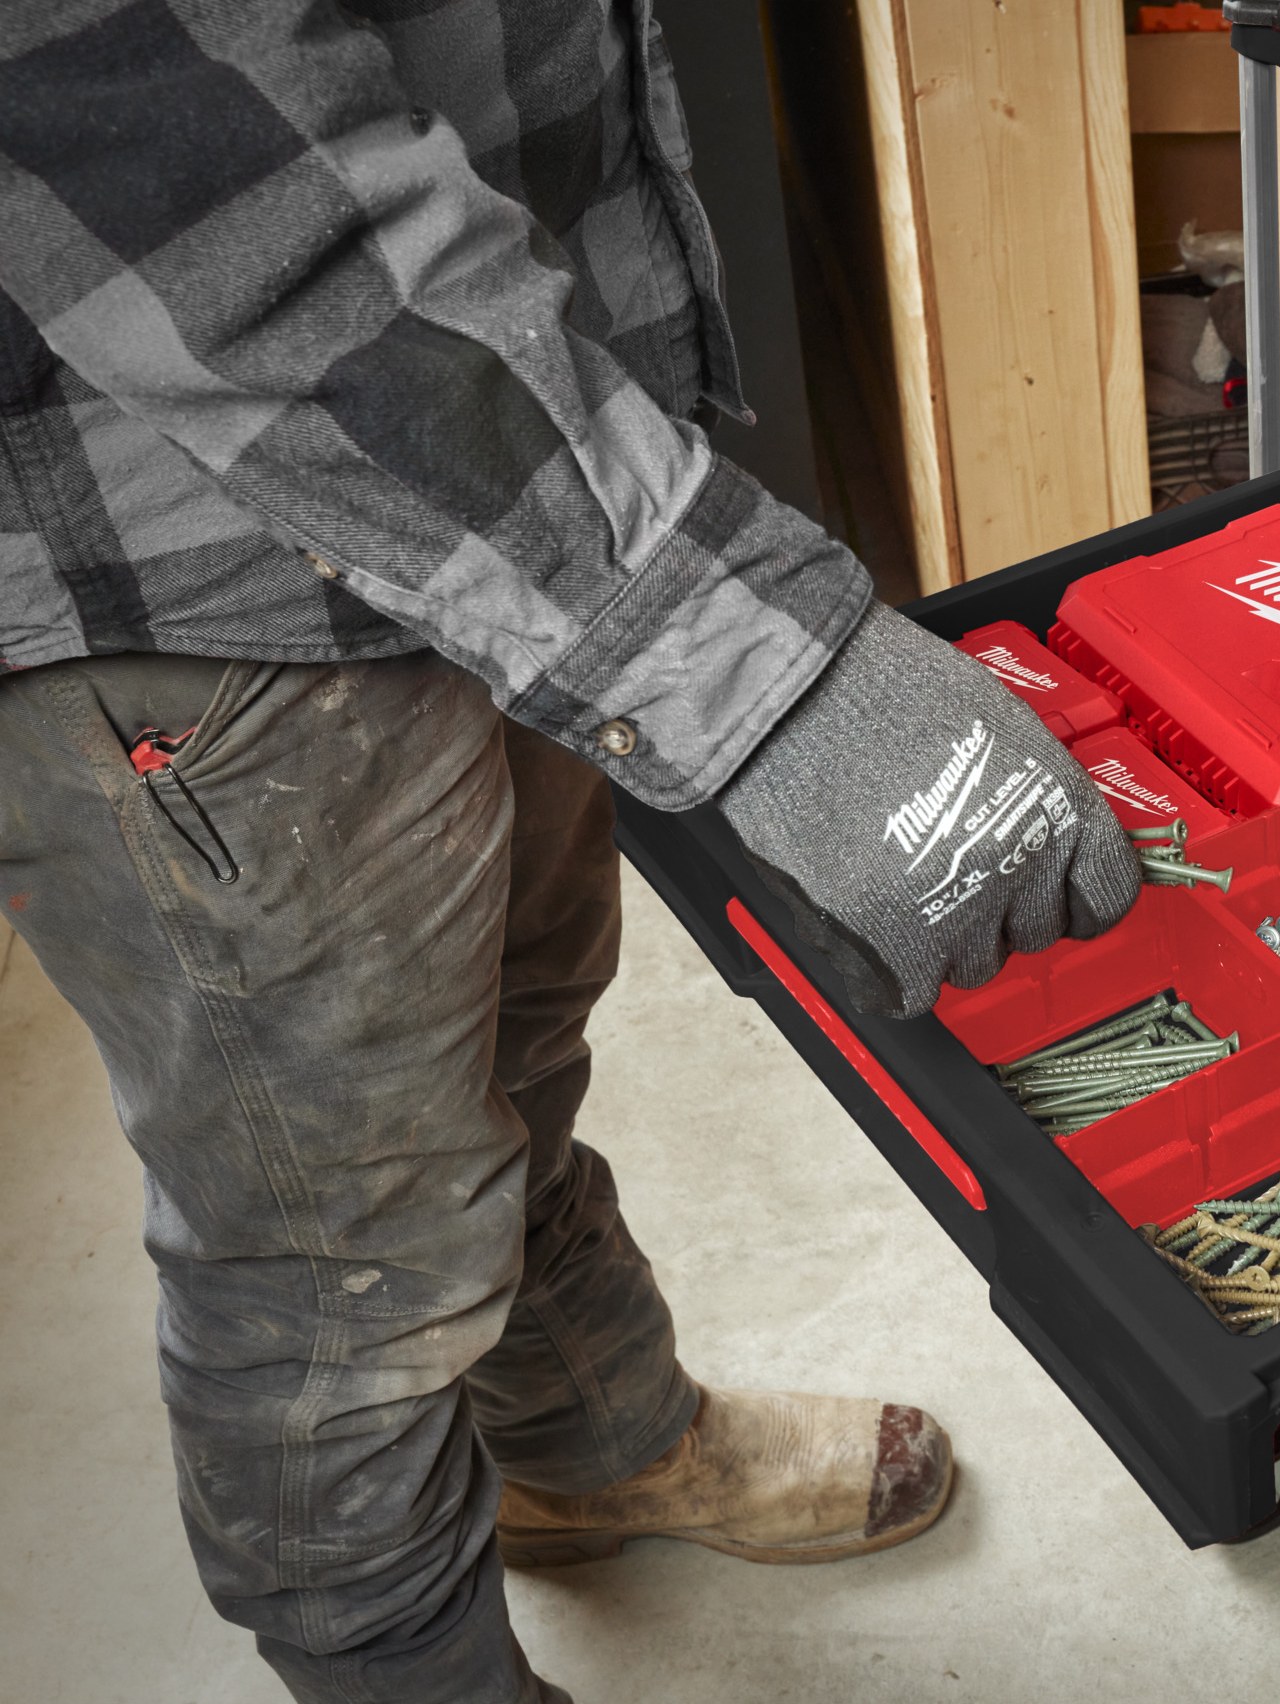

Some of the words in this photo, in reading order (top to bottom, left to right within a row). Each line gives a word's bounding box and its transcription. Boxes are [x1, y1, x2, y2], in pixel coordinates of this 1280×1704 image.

[976, 645, 1059, 690] Milwaukee
[964, 803, 991, 831] CUT
[989, 771, 1027, 806] LEVEL
[1025, 757, 1037, 769] 5
[1087, 758, 1179, 815] Milwaukee
[961, 869, 991, 889] XL
